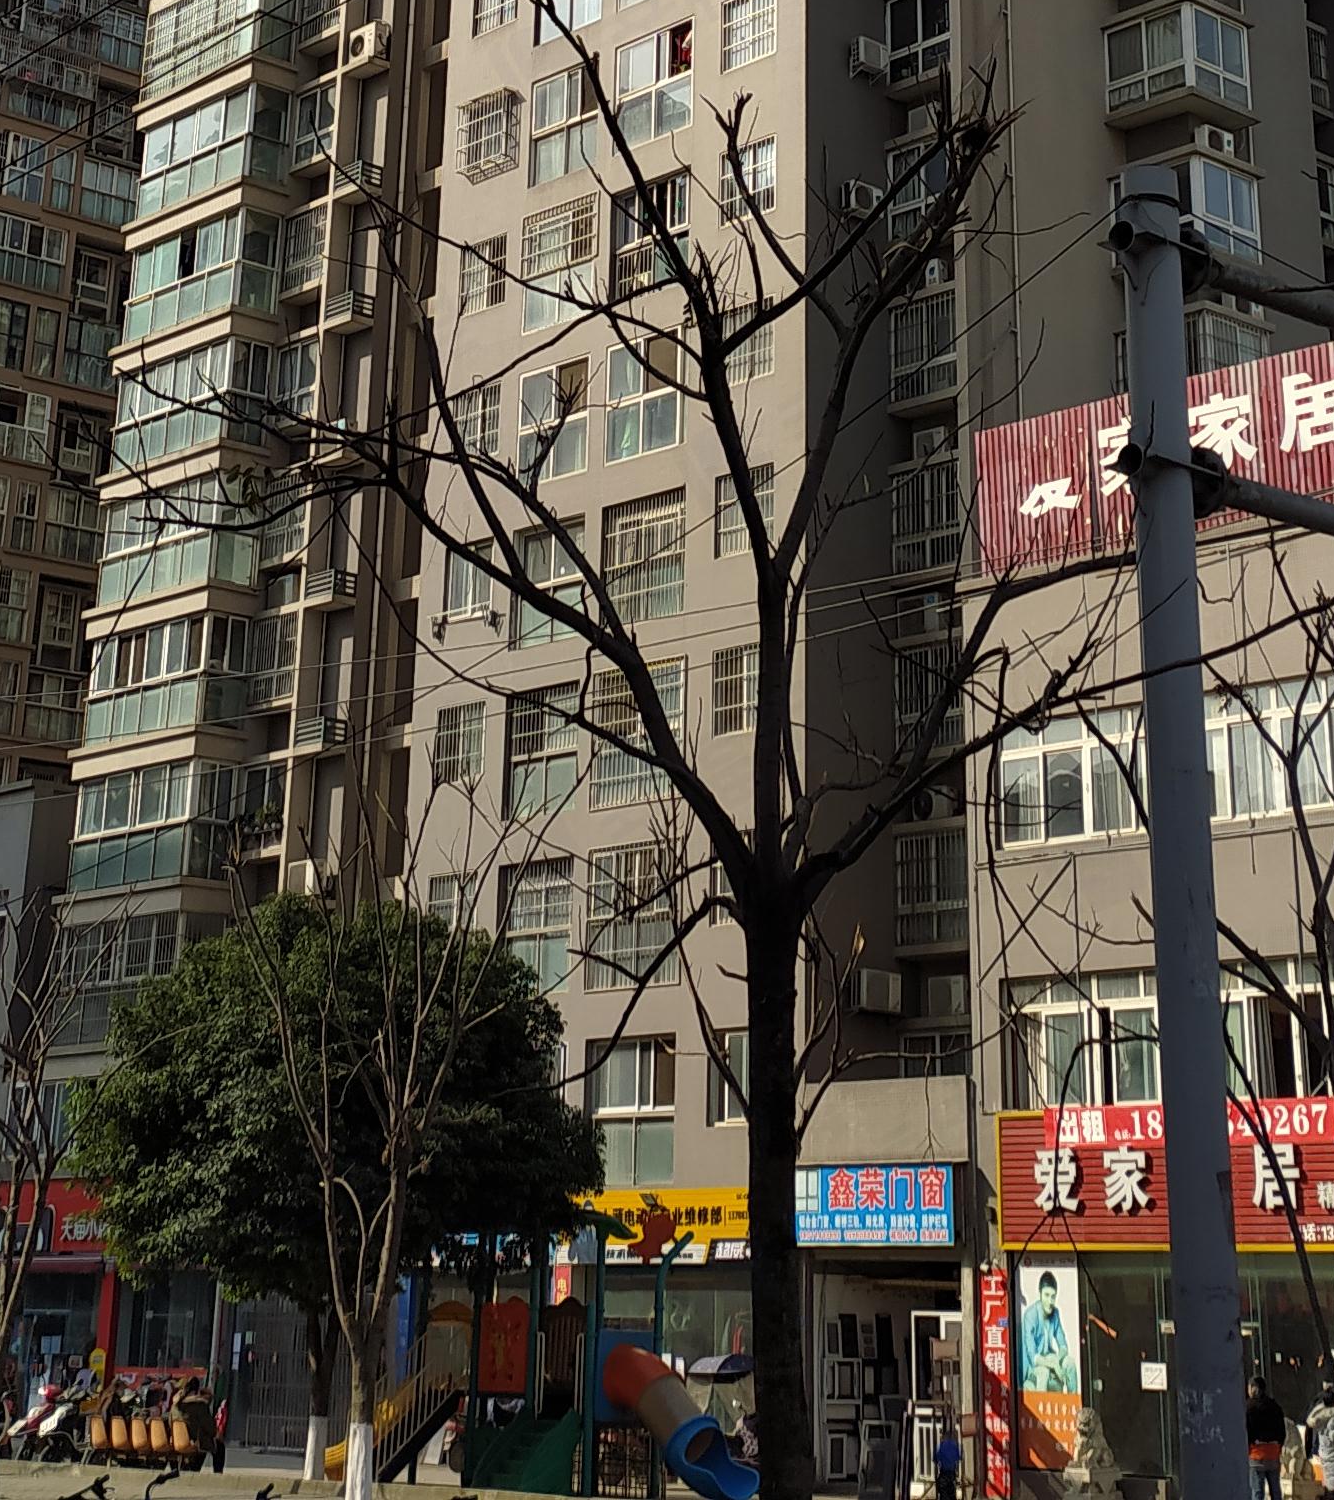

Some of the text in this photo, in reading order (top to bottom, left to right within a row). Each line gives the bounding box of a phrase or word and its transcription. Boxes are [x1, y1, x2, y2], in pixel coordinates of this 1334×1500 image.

[1056, 1110, 1106, 1143] 出租
[828, 1167, 947, 1211] 鑫荣门窗
[1034, 1143, 1300, 1212] 爱家居
[982, 1275, 1006, 1375] 工厂直销
